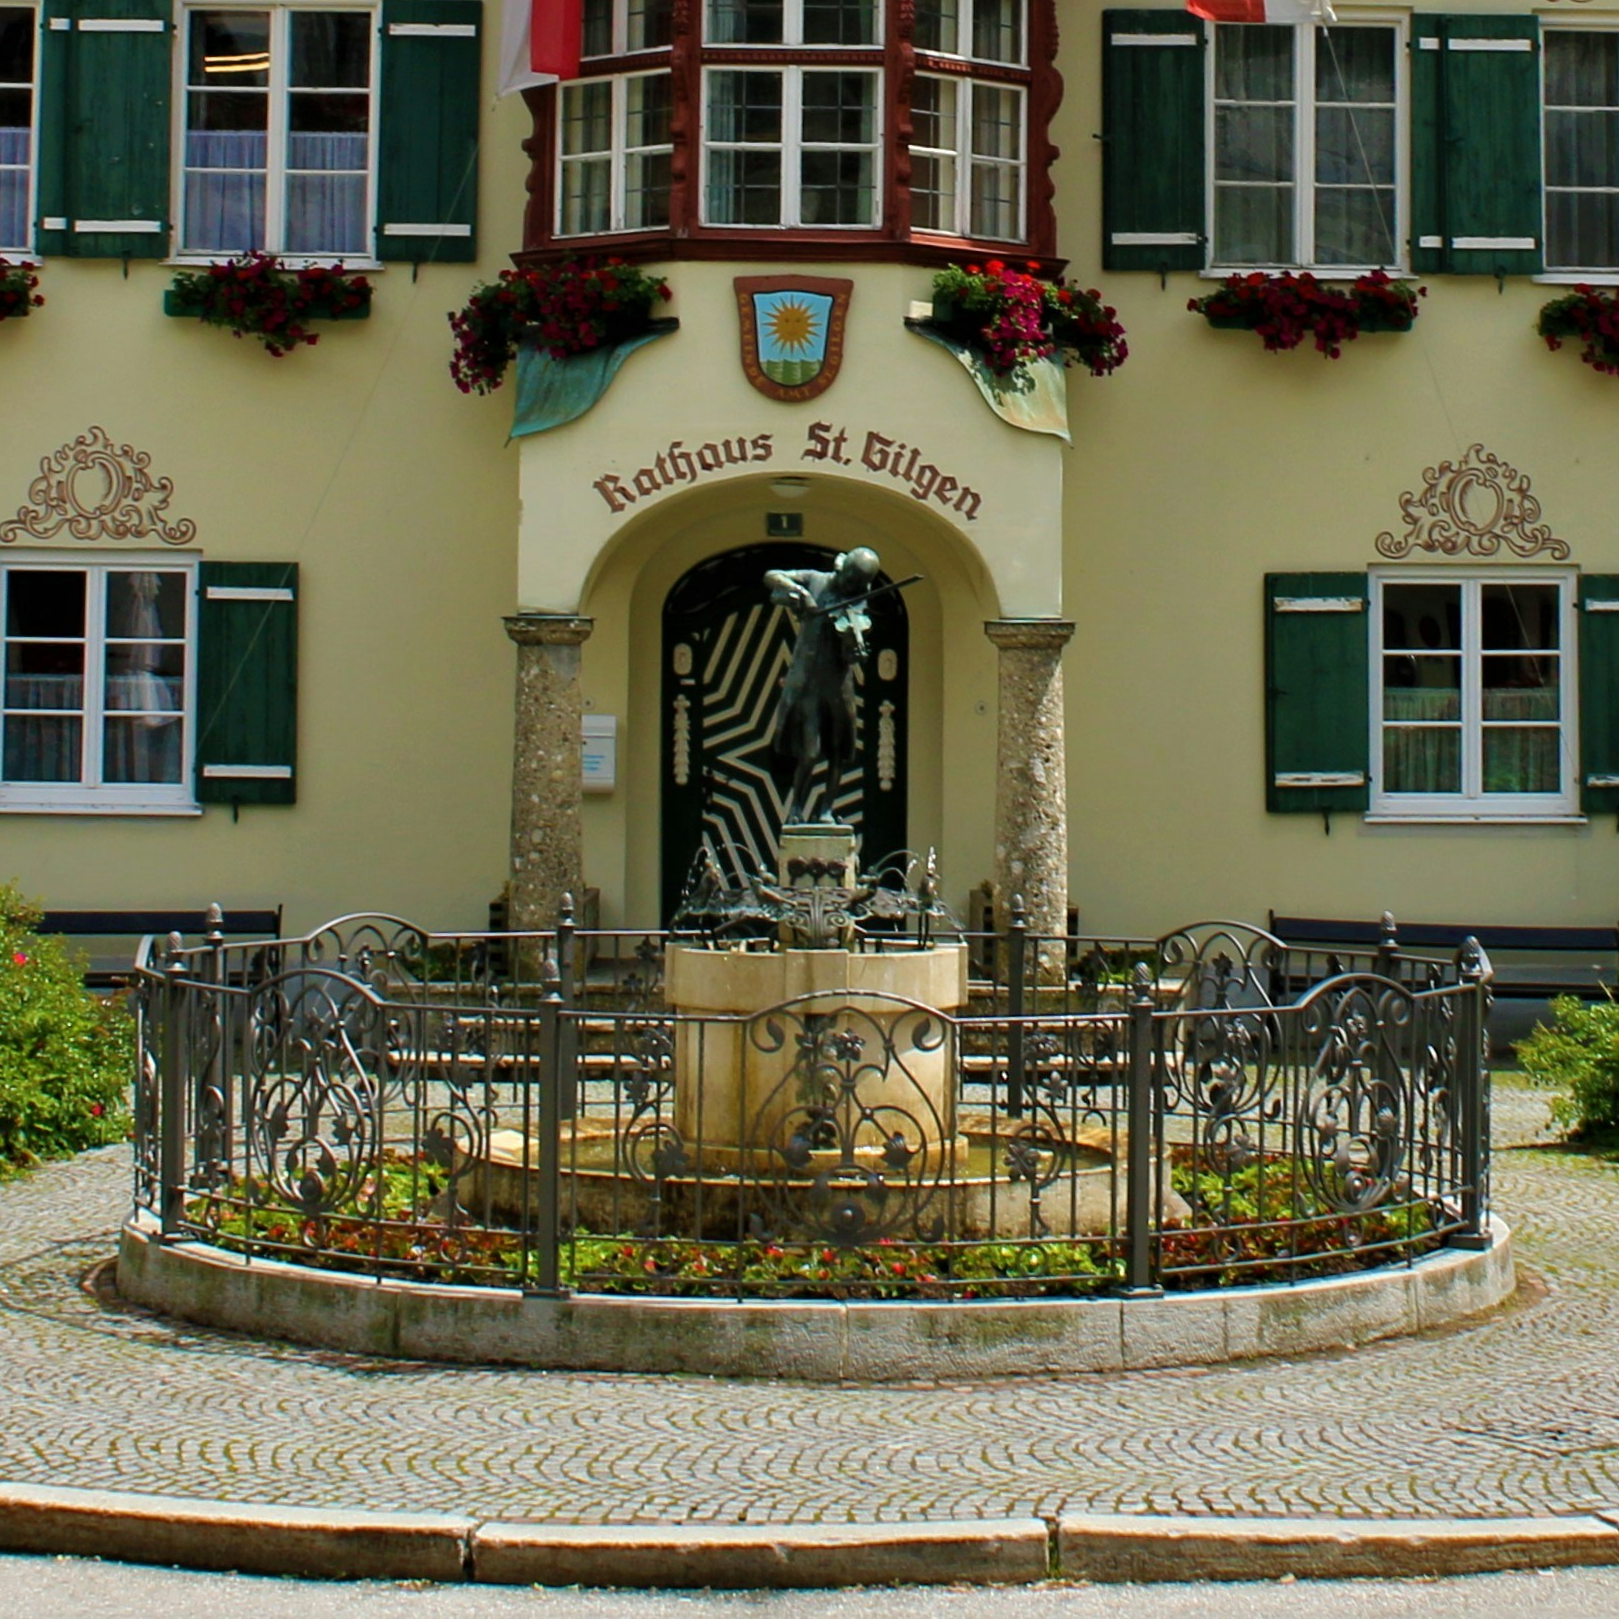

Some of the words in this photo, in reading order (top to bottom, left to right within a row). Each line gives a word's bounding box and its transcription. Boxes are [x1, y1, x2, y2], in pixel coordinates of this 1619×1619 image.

[778, 387, 810, 398] AMT
[829, 293, 846, 365] GILGEN
[593, 433, 773, 513] Rathaus
[800, 420, 852, 466] St.
[861, 431, 982, 521] Gilgen
[781, 515, 787, 529] 1
